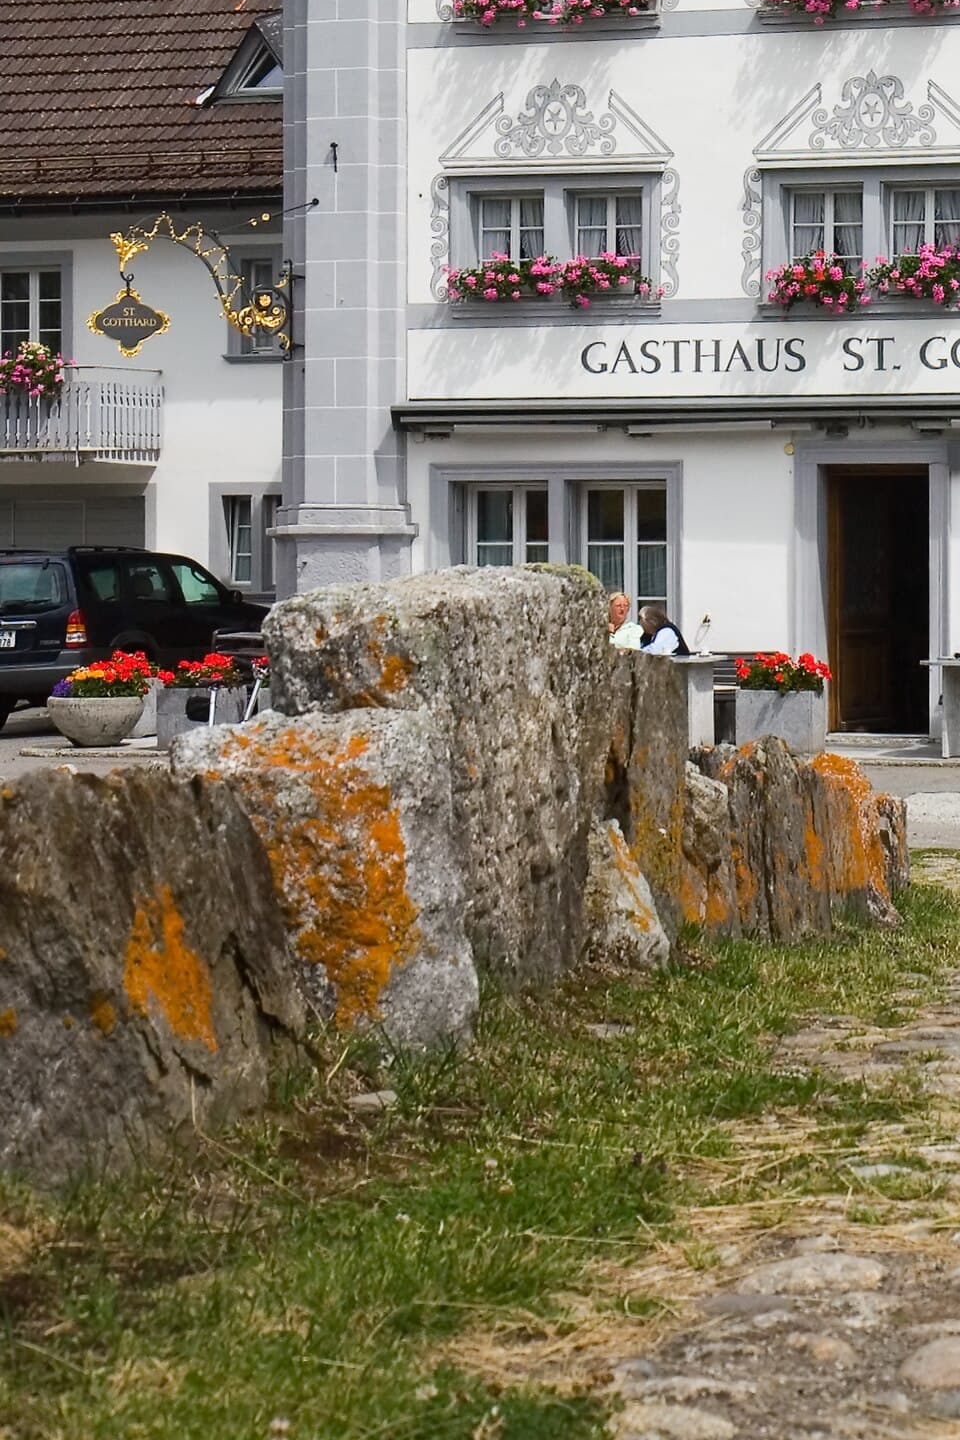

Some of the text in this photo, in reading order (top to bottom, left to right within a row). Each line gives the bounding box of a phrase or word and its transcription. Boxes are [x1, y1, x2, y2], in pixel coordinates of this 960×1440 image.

[122, 307, 136, 317] ST
[102, 317, 157, 327] GOTTHARD
[580, 337, 807, 374] GASTHAUS
[842, 336, 901, 372] ST.
